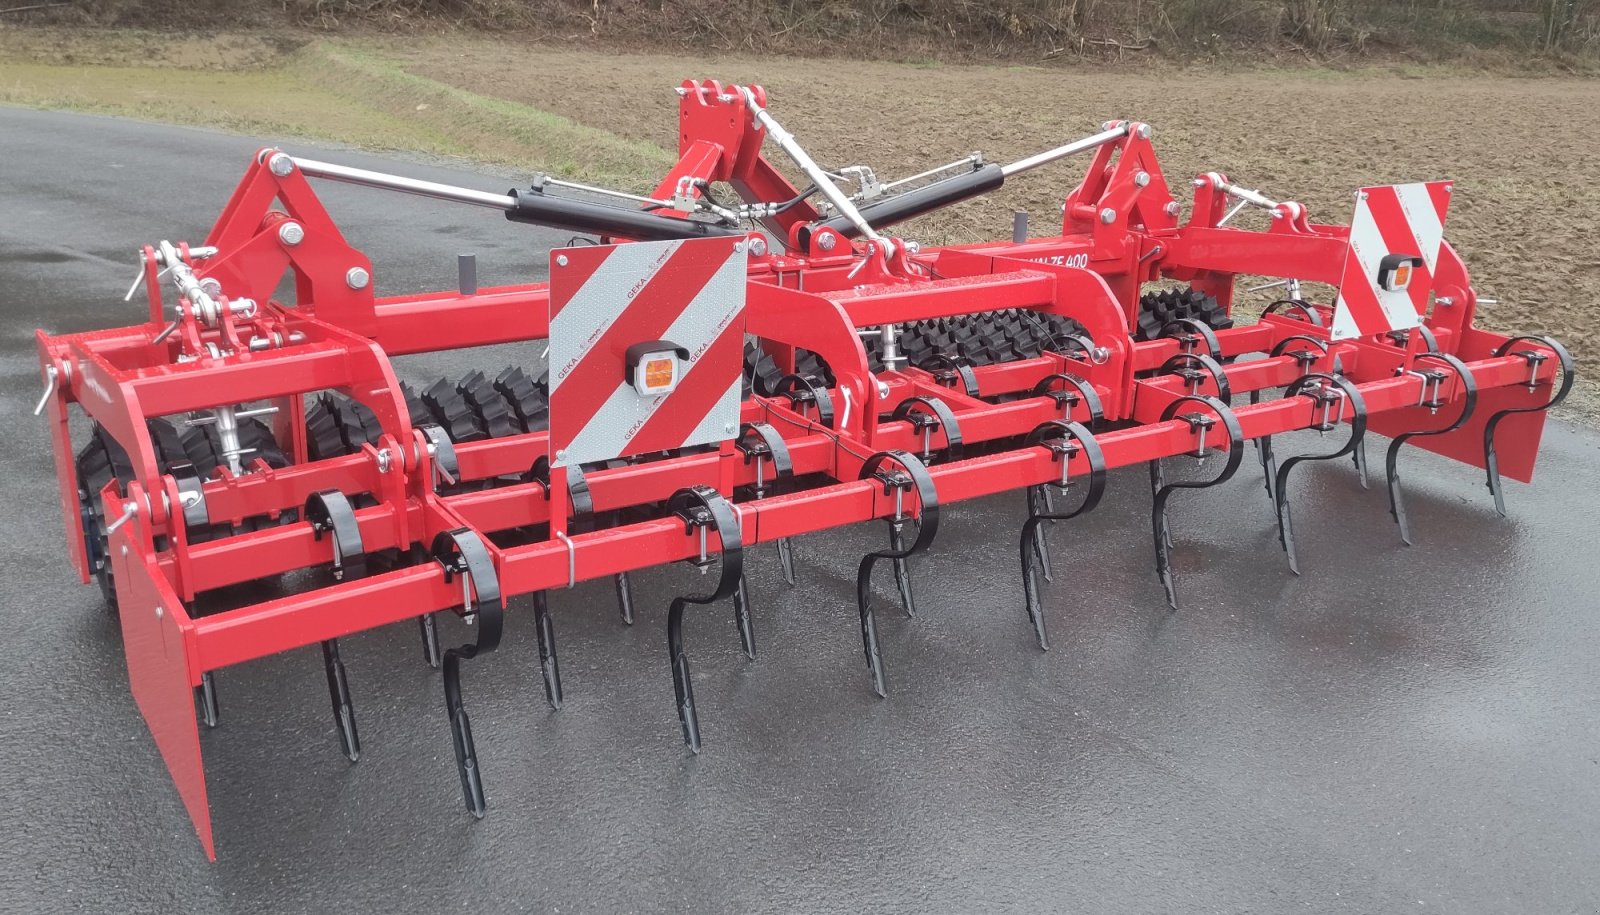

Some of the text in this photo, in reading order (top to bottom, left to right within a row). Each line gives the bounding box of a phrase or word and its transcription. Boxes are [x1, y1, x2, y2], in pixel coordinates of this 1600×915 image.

[1065, 253, 1088, 269] 400
[627, 278, 647, 299] GEKA
[690, 343, 708, 363] GEKA
[558, 358, 578, 379] GEKA
[625, 420, 643, 440] GEKA
